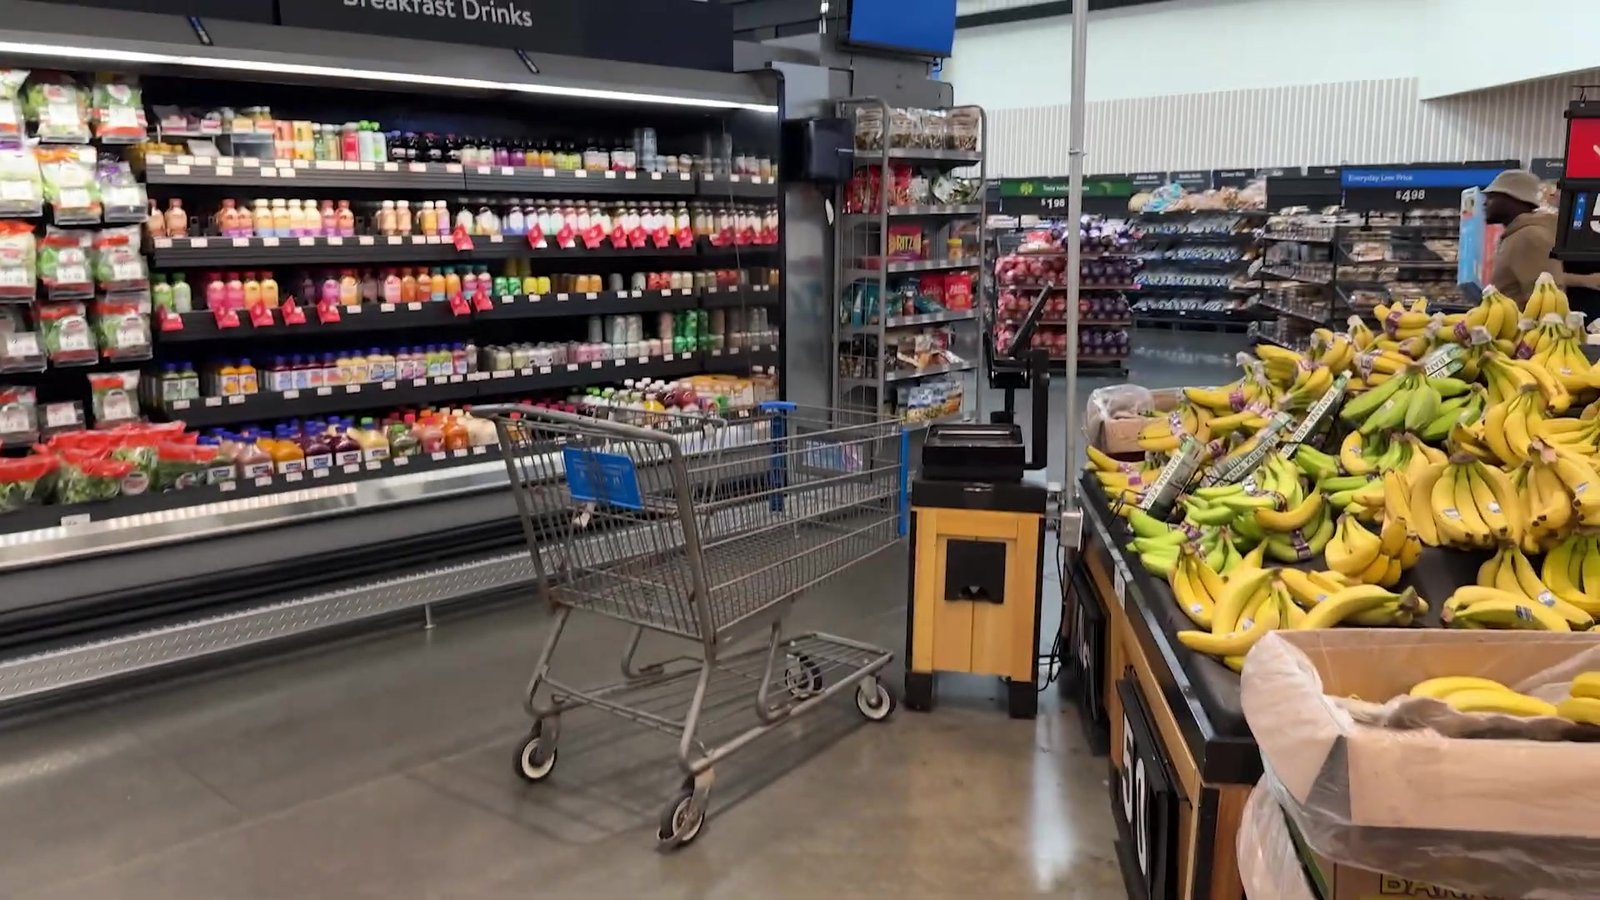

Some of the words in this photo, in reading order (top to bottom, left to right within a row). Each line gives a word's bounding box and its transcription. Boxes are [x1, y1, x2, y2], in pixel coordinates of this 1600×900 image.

[463, 0, 533, 27] Drinks
[896, 235, 913, 250] RITZ
[1307, 389, 1336, 424] BANANA
[1244, 436, 1275, 465] KEEPER
[1157, 454, 1181, 487] BANANA
